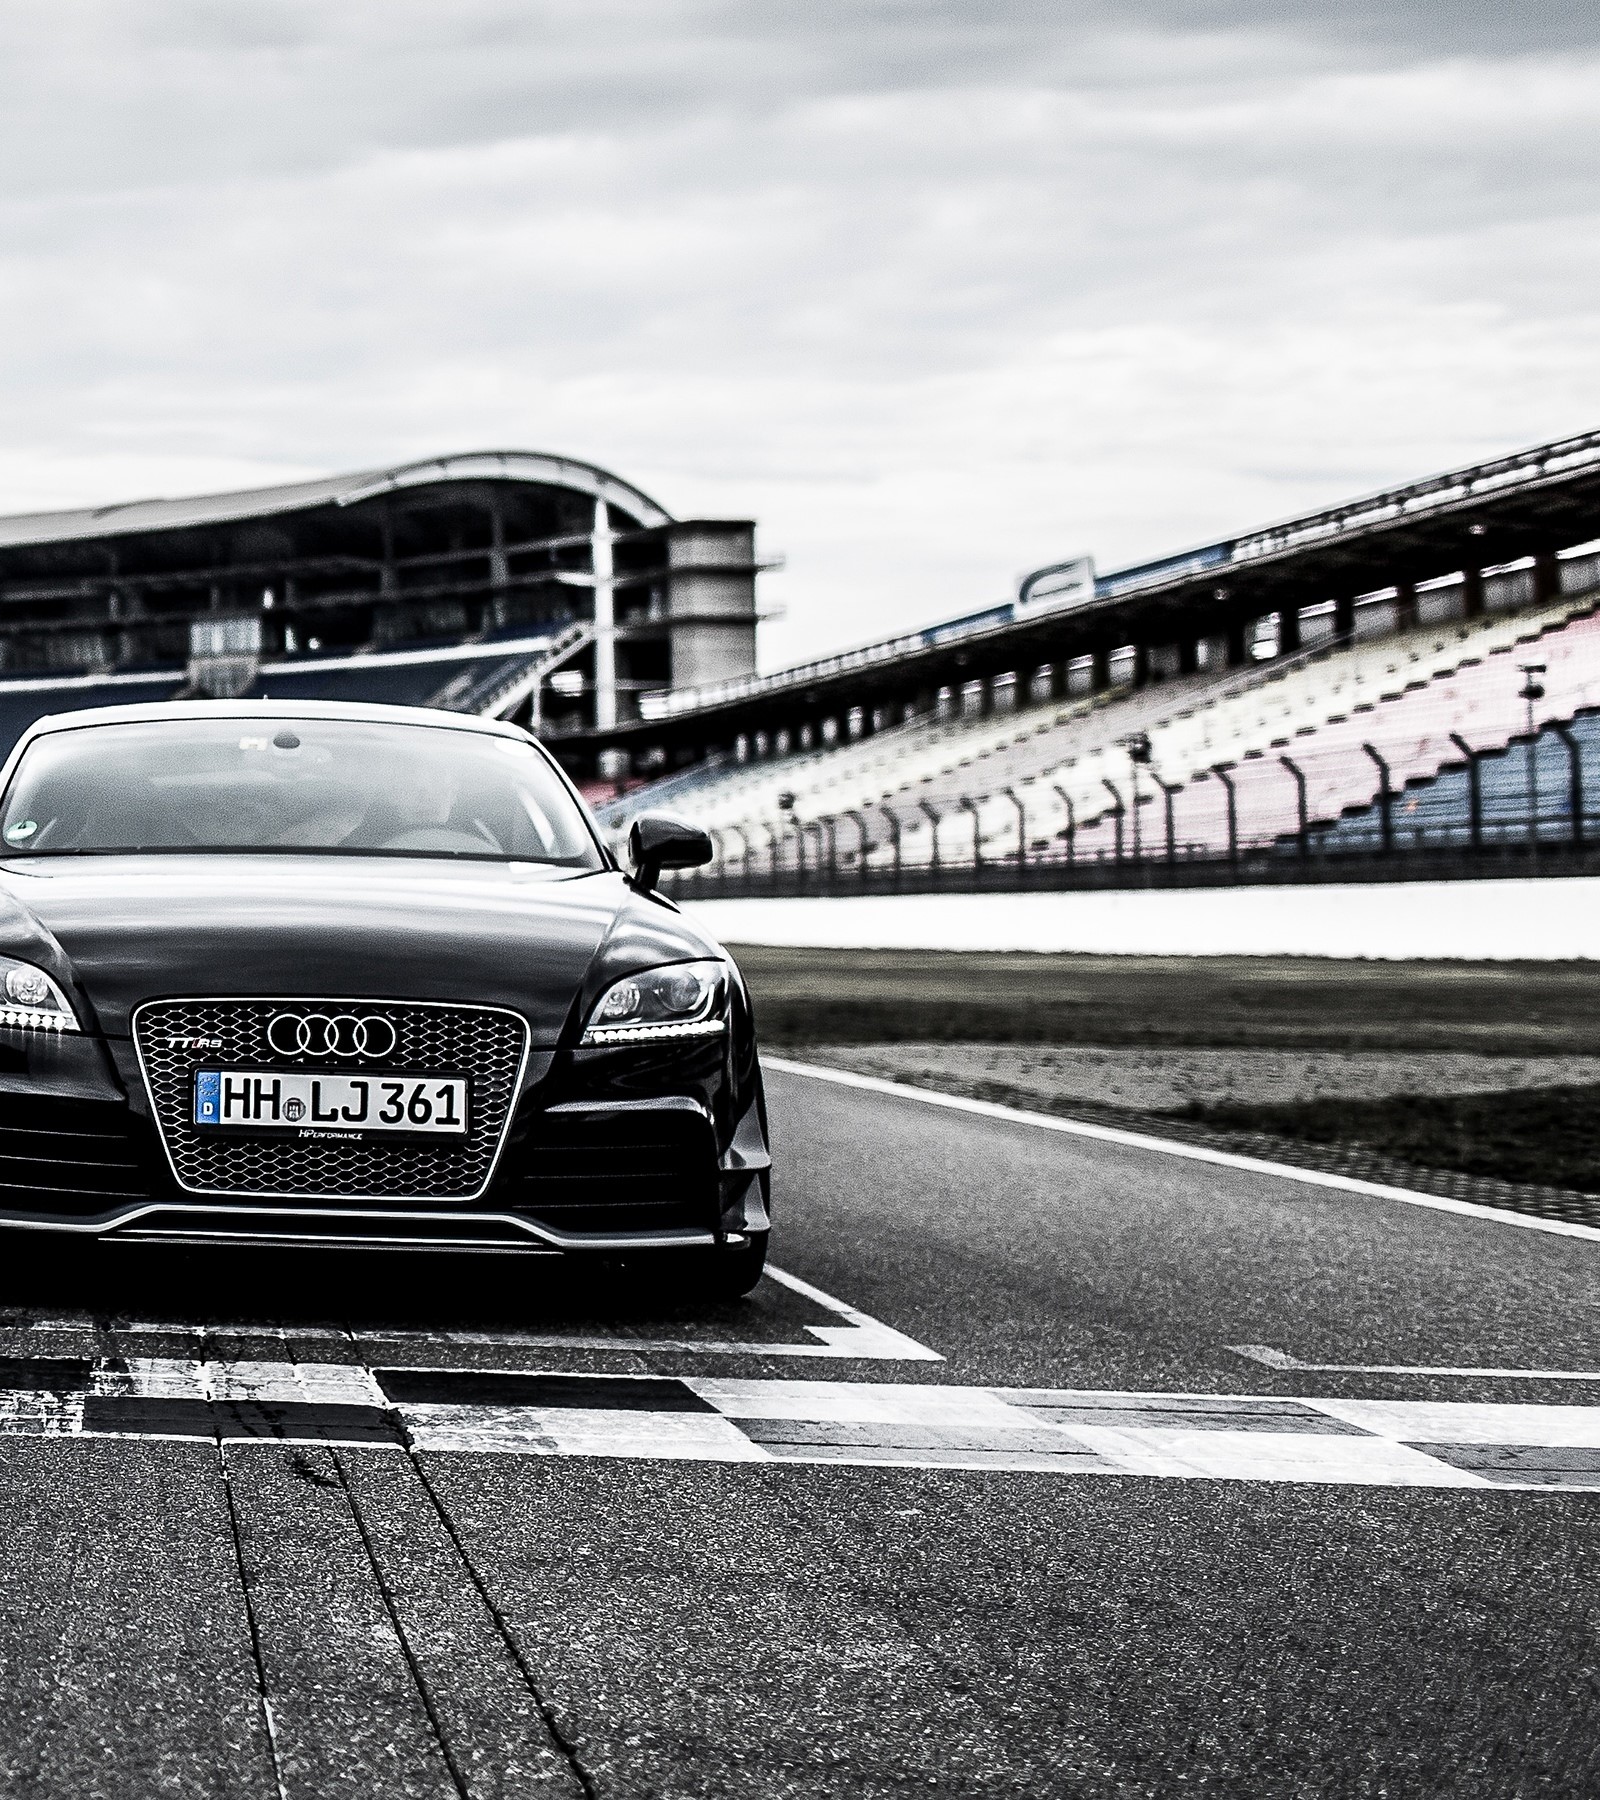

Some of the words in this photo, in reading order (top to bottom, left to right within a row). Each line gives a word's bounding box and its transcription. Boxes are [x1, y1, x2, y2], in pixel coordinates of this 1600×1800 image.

[203, 1102, 213, 1115] D
[224, 1077, 281, 1120] HH
[311, 1080, 369, 1122] LJ
[379, 1083, 460, 1125] 361
